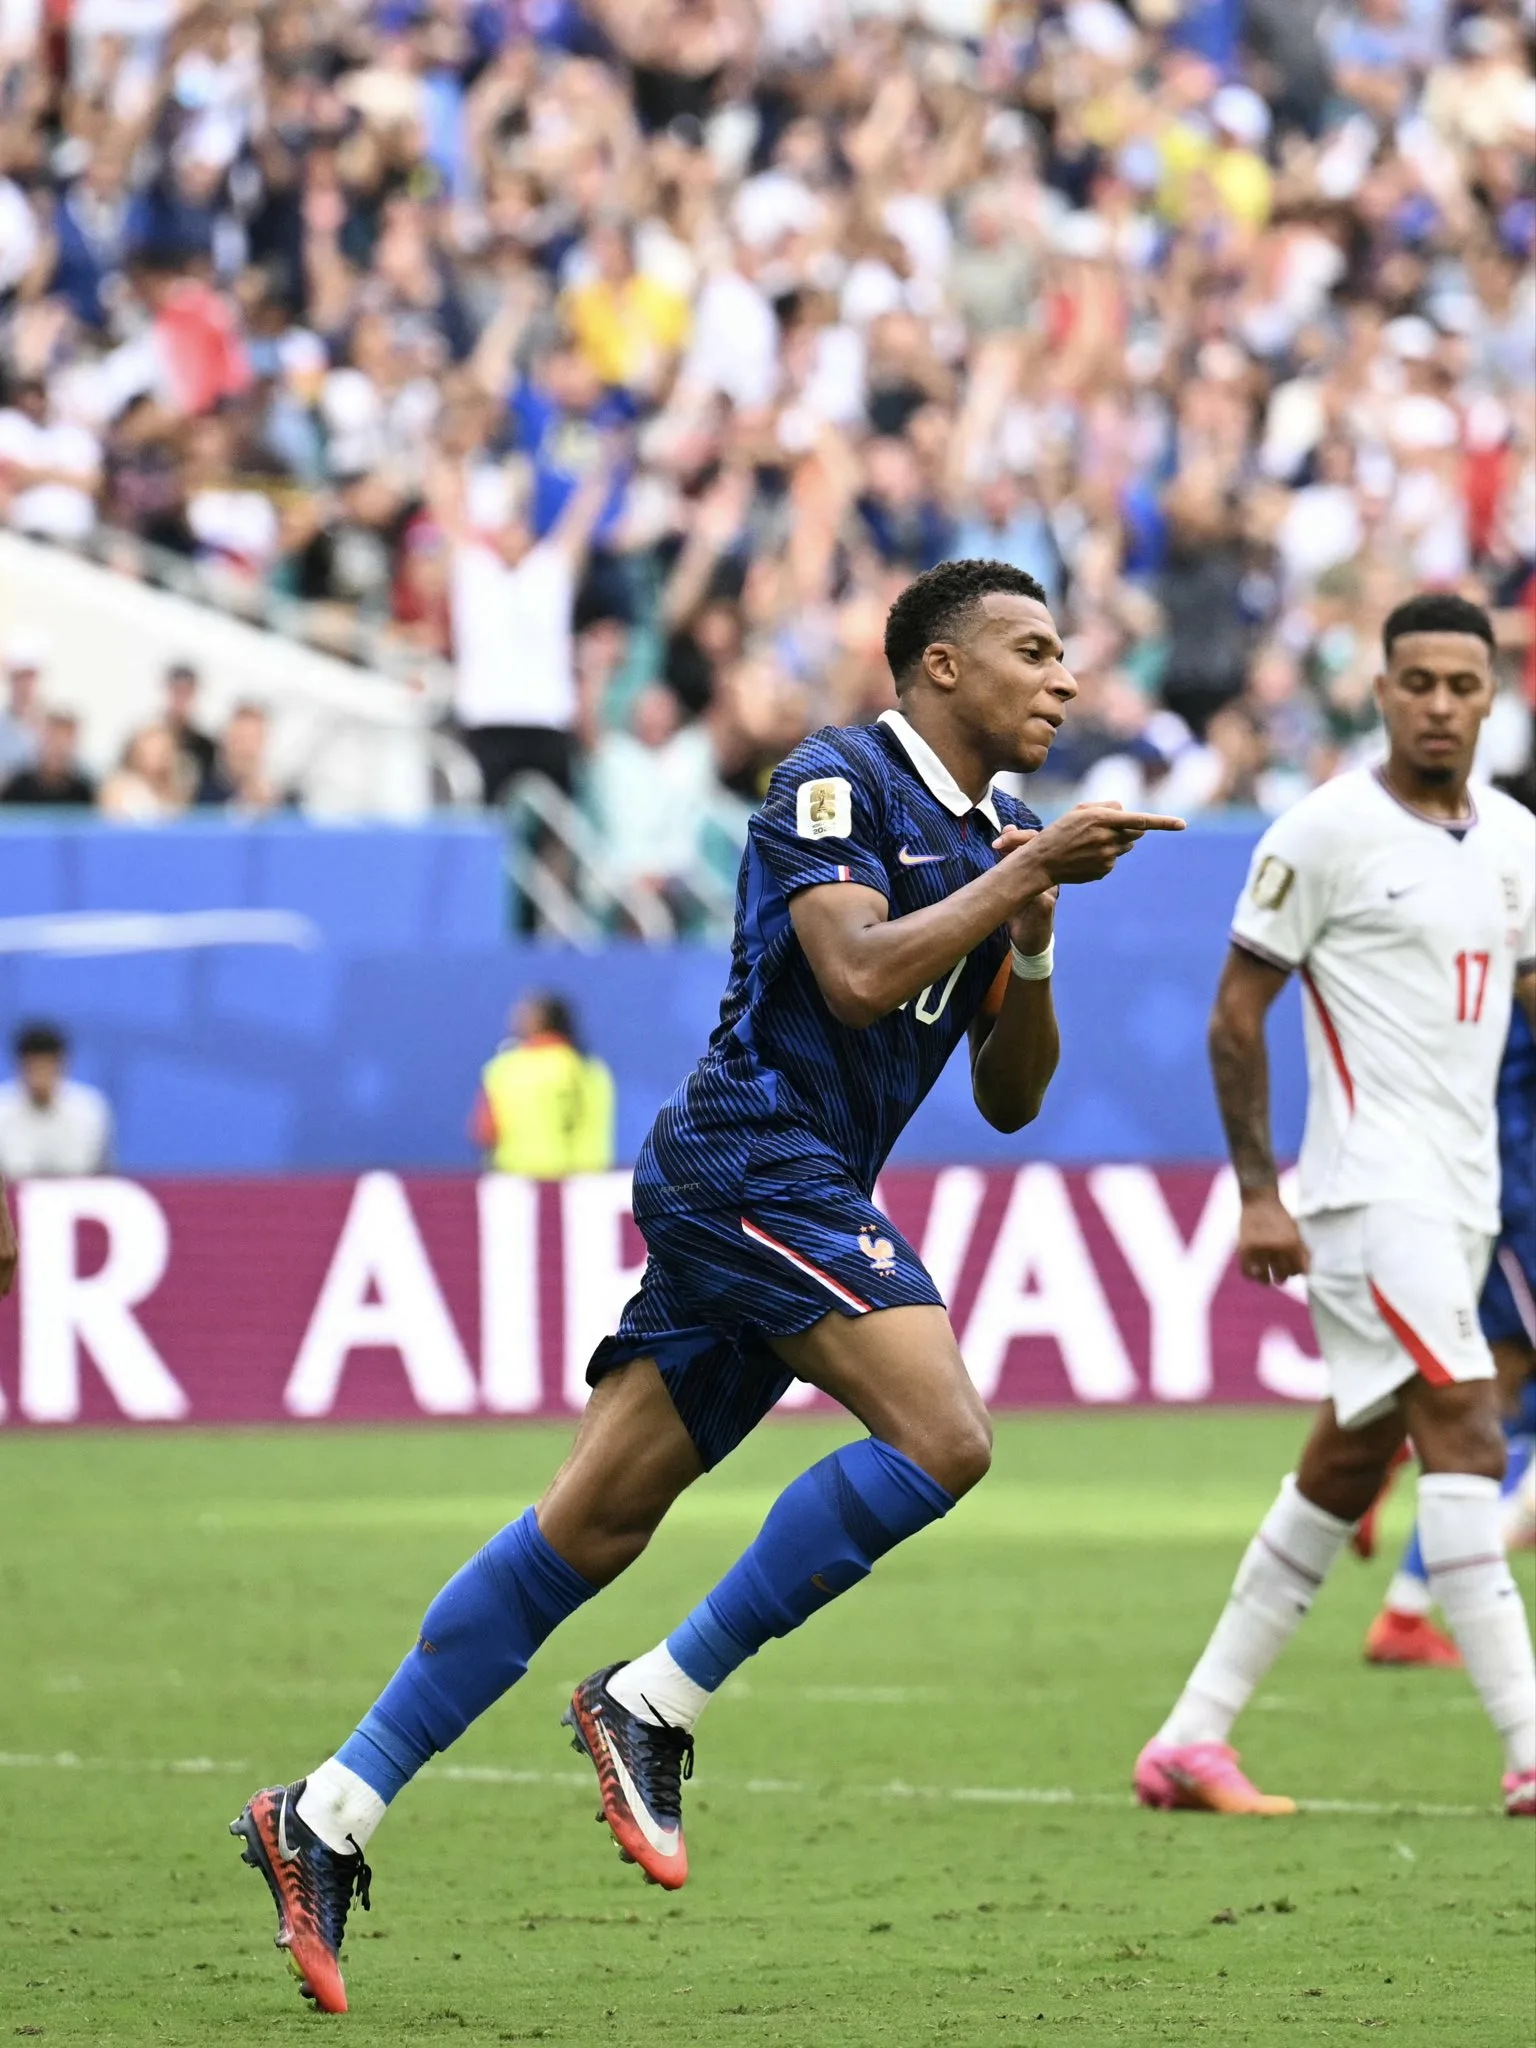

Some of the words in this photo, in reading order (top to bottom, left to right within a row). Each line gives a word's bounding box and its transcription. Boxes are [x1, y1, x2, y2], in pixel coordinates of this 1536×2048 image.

[898, 955, 968, 1026] 0
[1455, 950, 1491, 1024] 17
[0, 1175, 192, 1423] R
